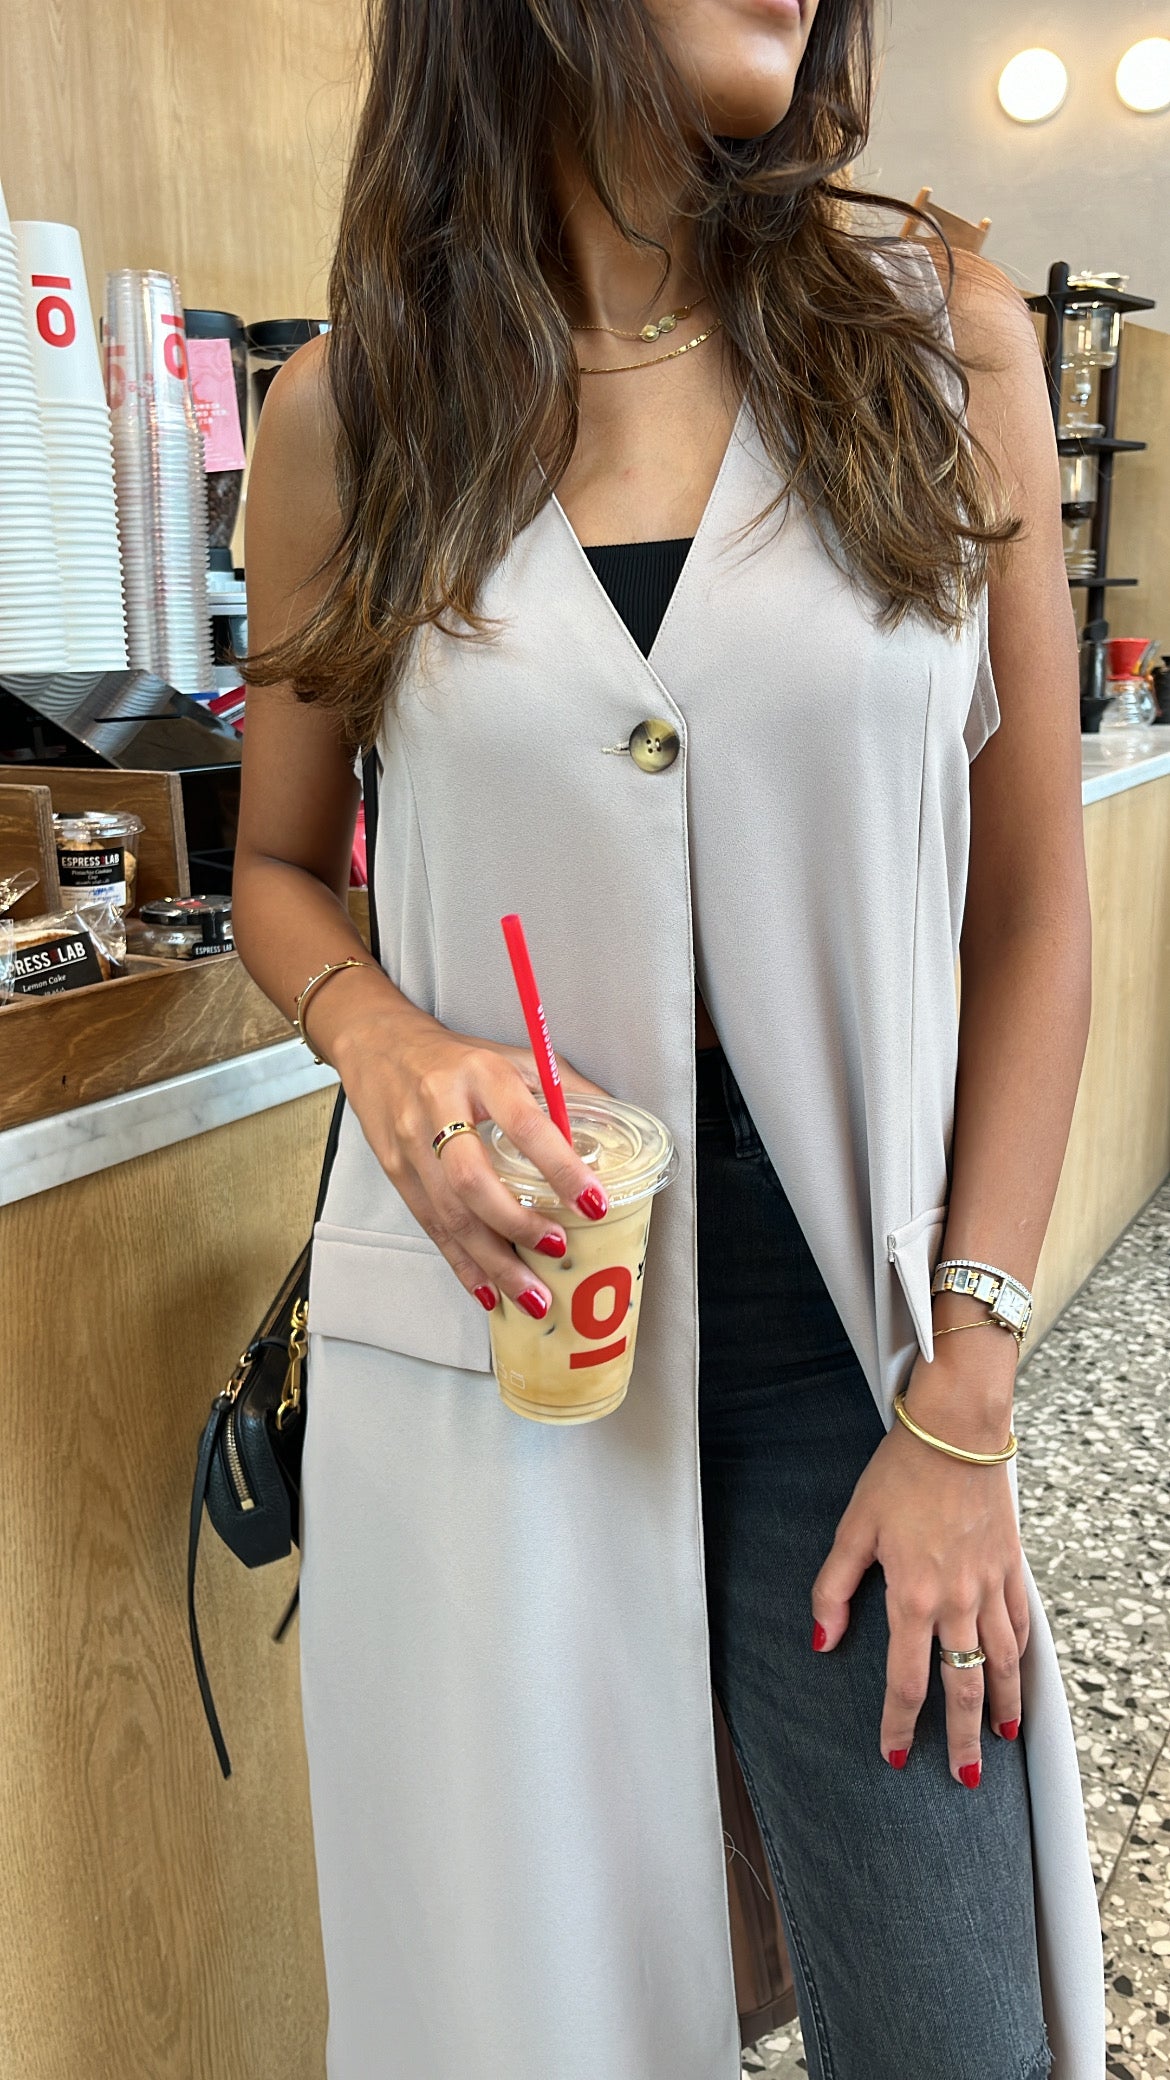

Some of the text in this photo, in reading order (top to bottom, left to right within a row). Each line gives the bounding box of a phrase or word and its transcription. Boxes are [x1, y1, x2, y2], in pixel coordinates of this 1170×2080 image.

[61, 853, 120, 867] ESPRESSOLAB
[22, 980, 48, 993] Lemon
[48, 974, 67, 985] Cake
